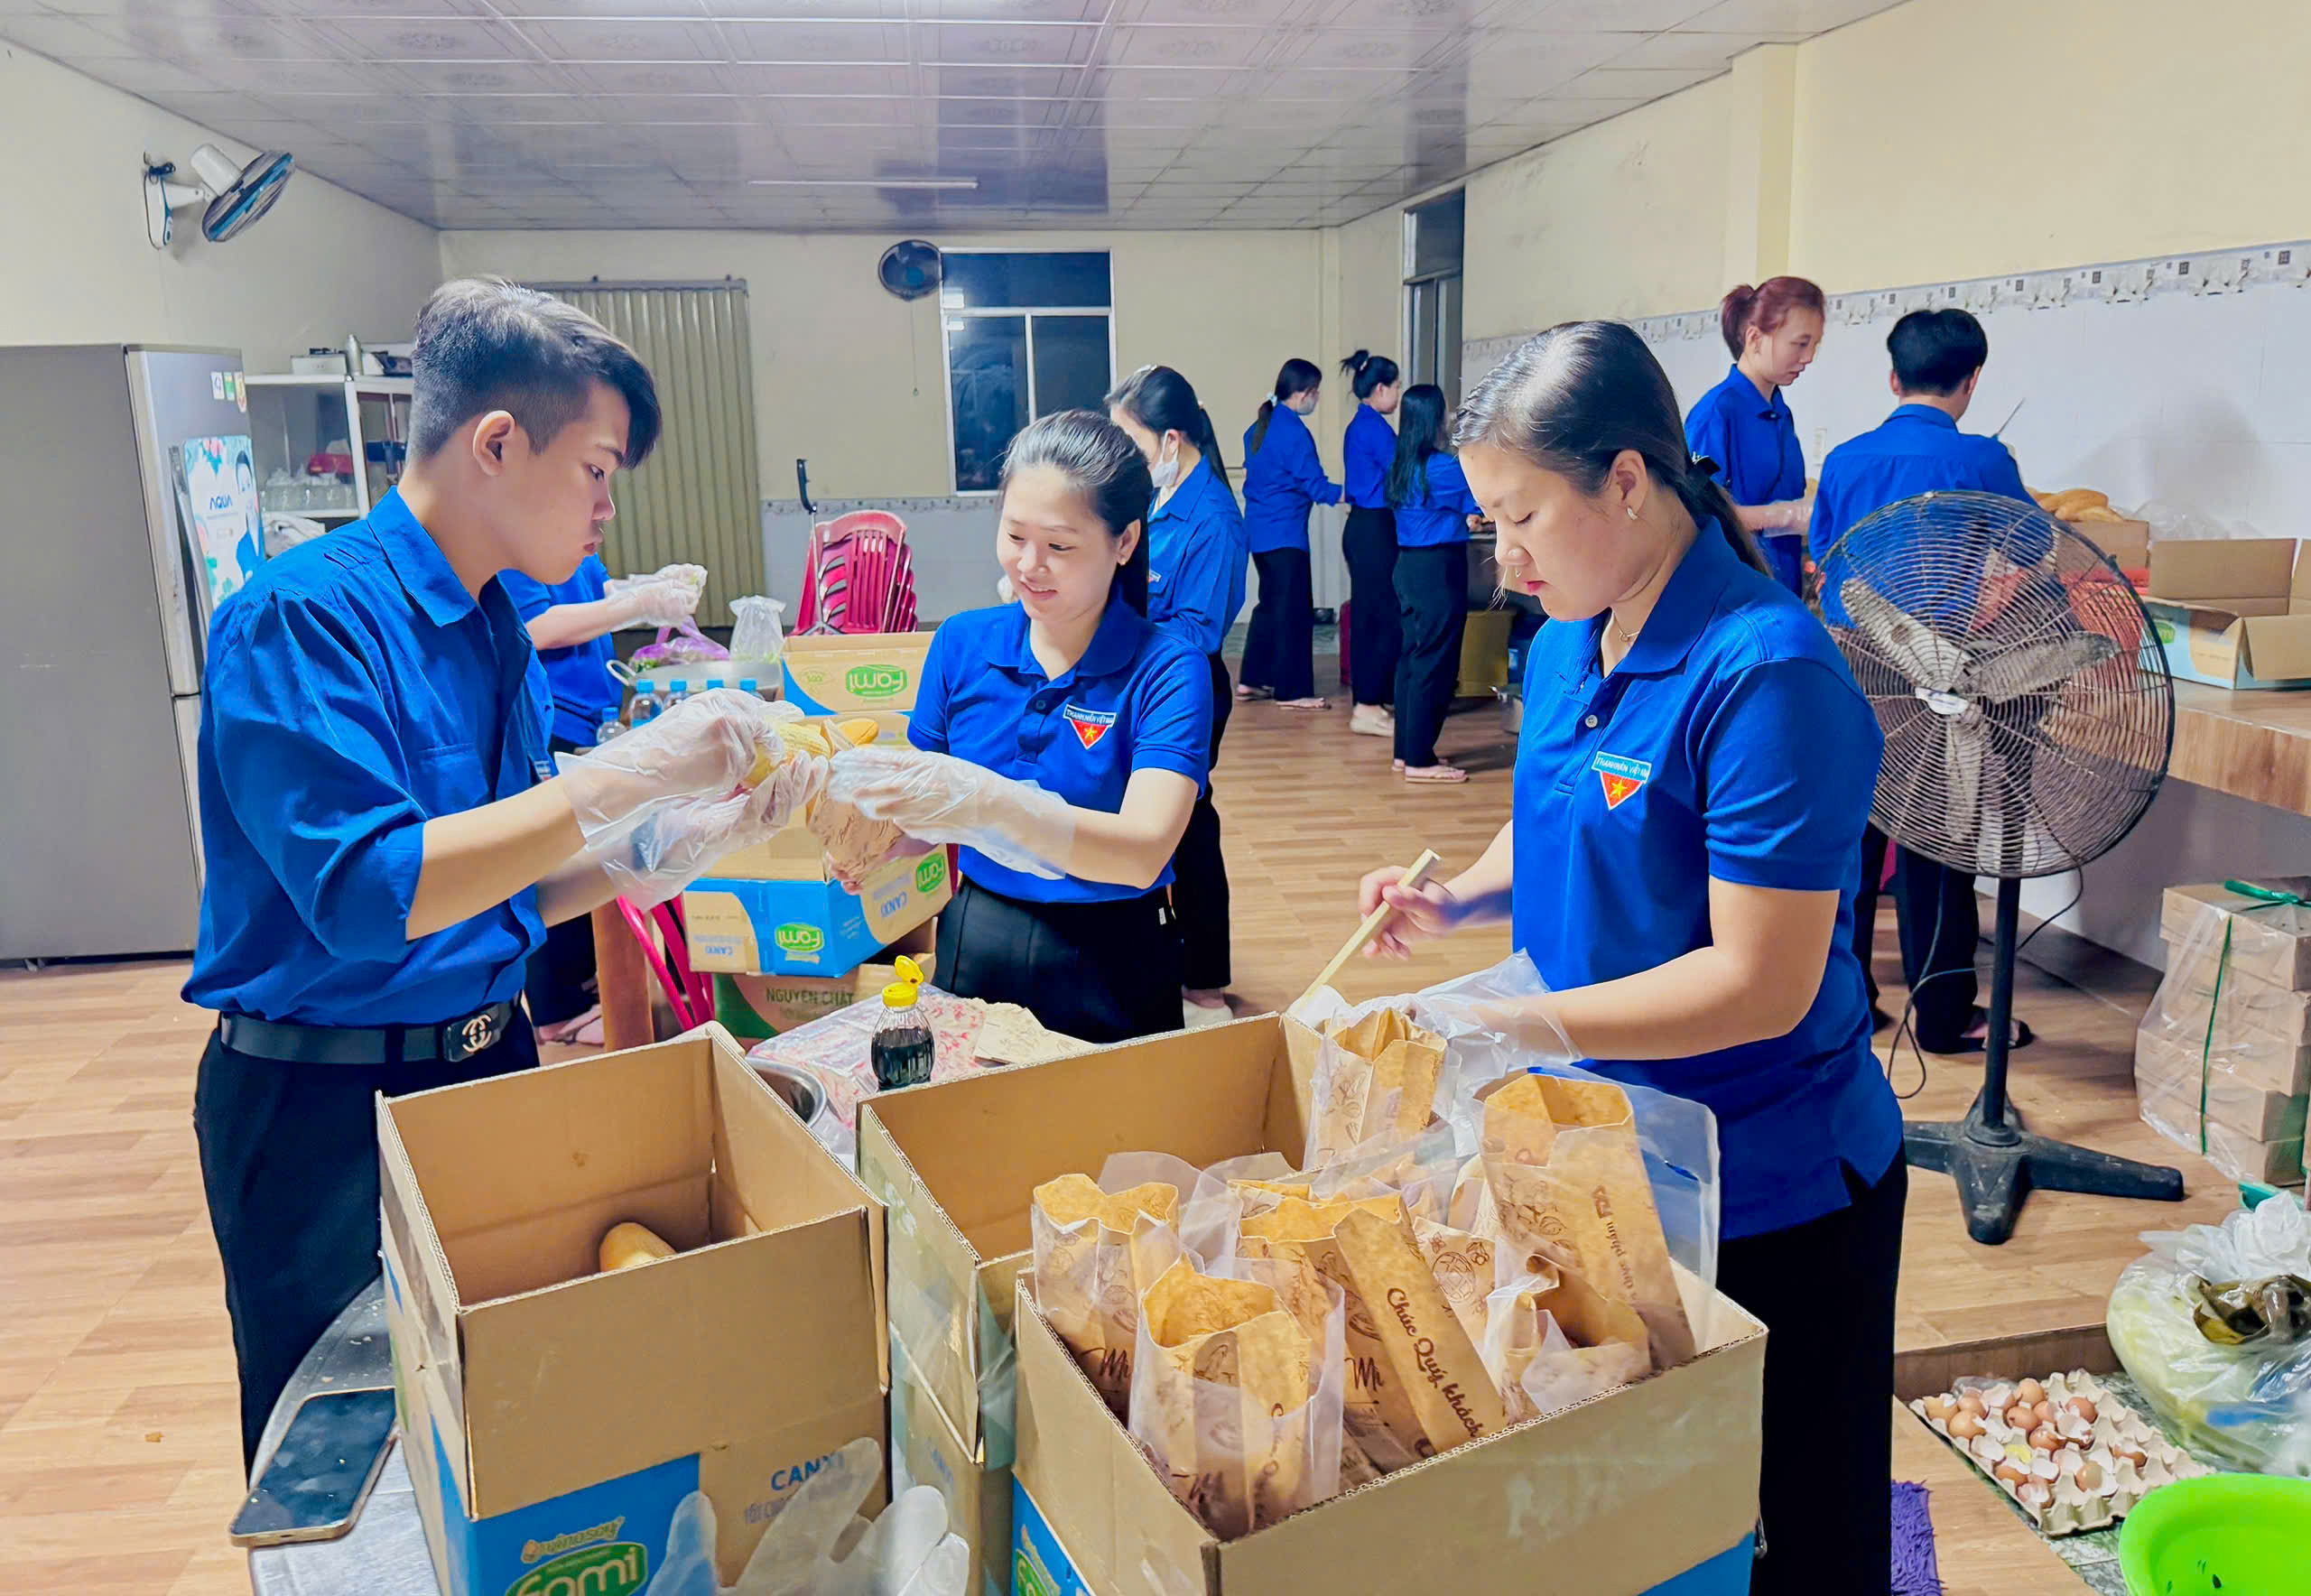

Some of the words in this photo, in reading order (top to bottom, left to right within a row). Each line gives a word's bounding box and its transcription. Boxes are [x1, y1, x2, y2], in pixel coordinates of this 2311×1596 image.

[209, 496, 232, 510] AQUA
[1387, 1287, 1417, 1337] Chúc
[1414, 1337, 1448, 1389] Quý
[1442, 1382, 1484, 1438] khách
